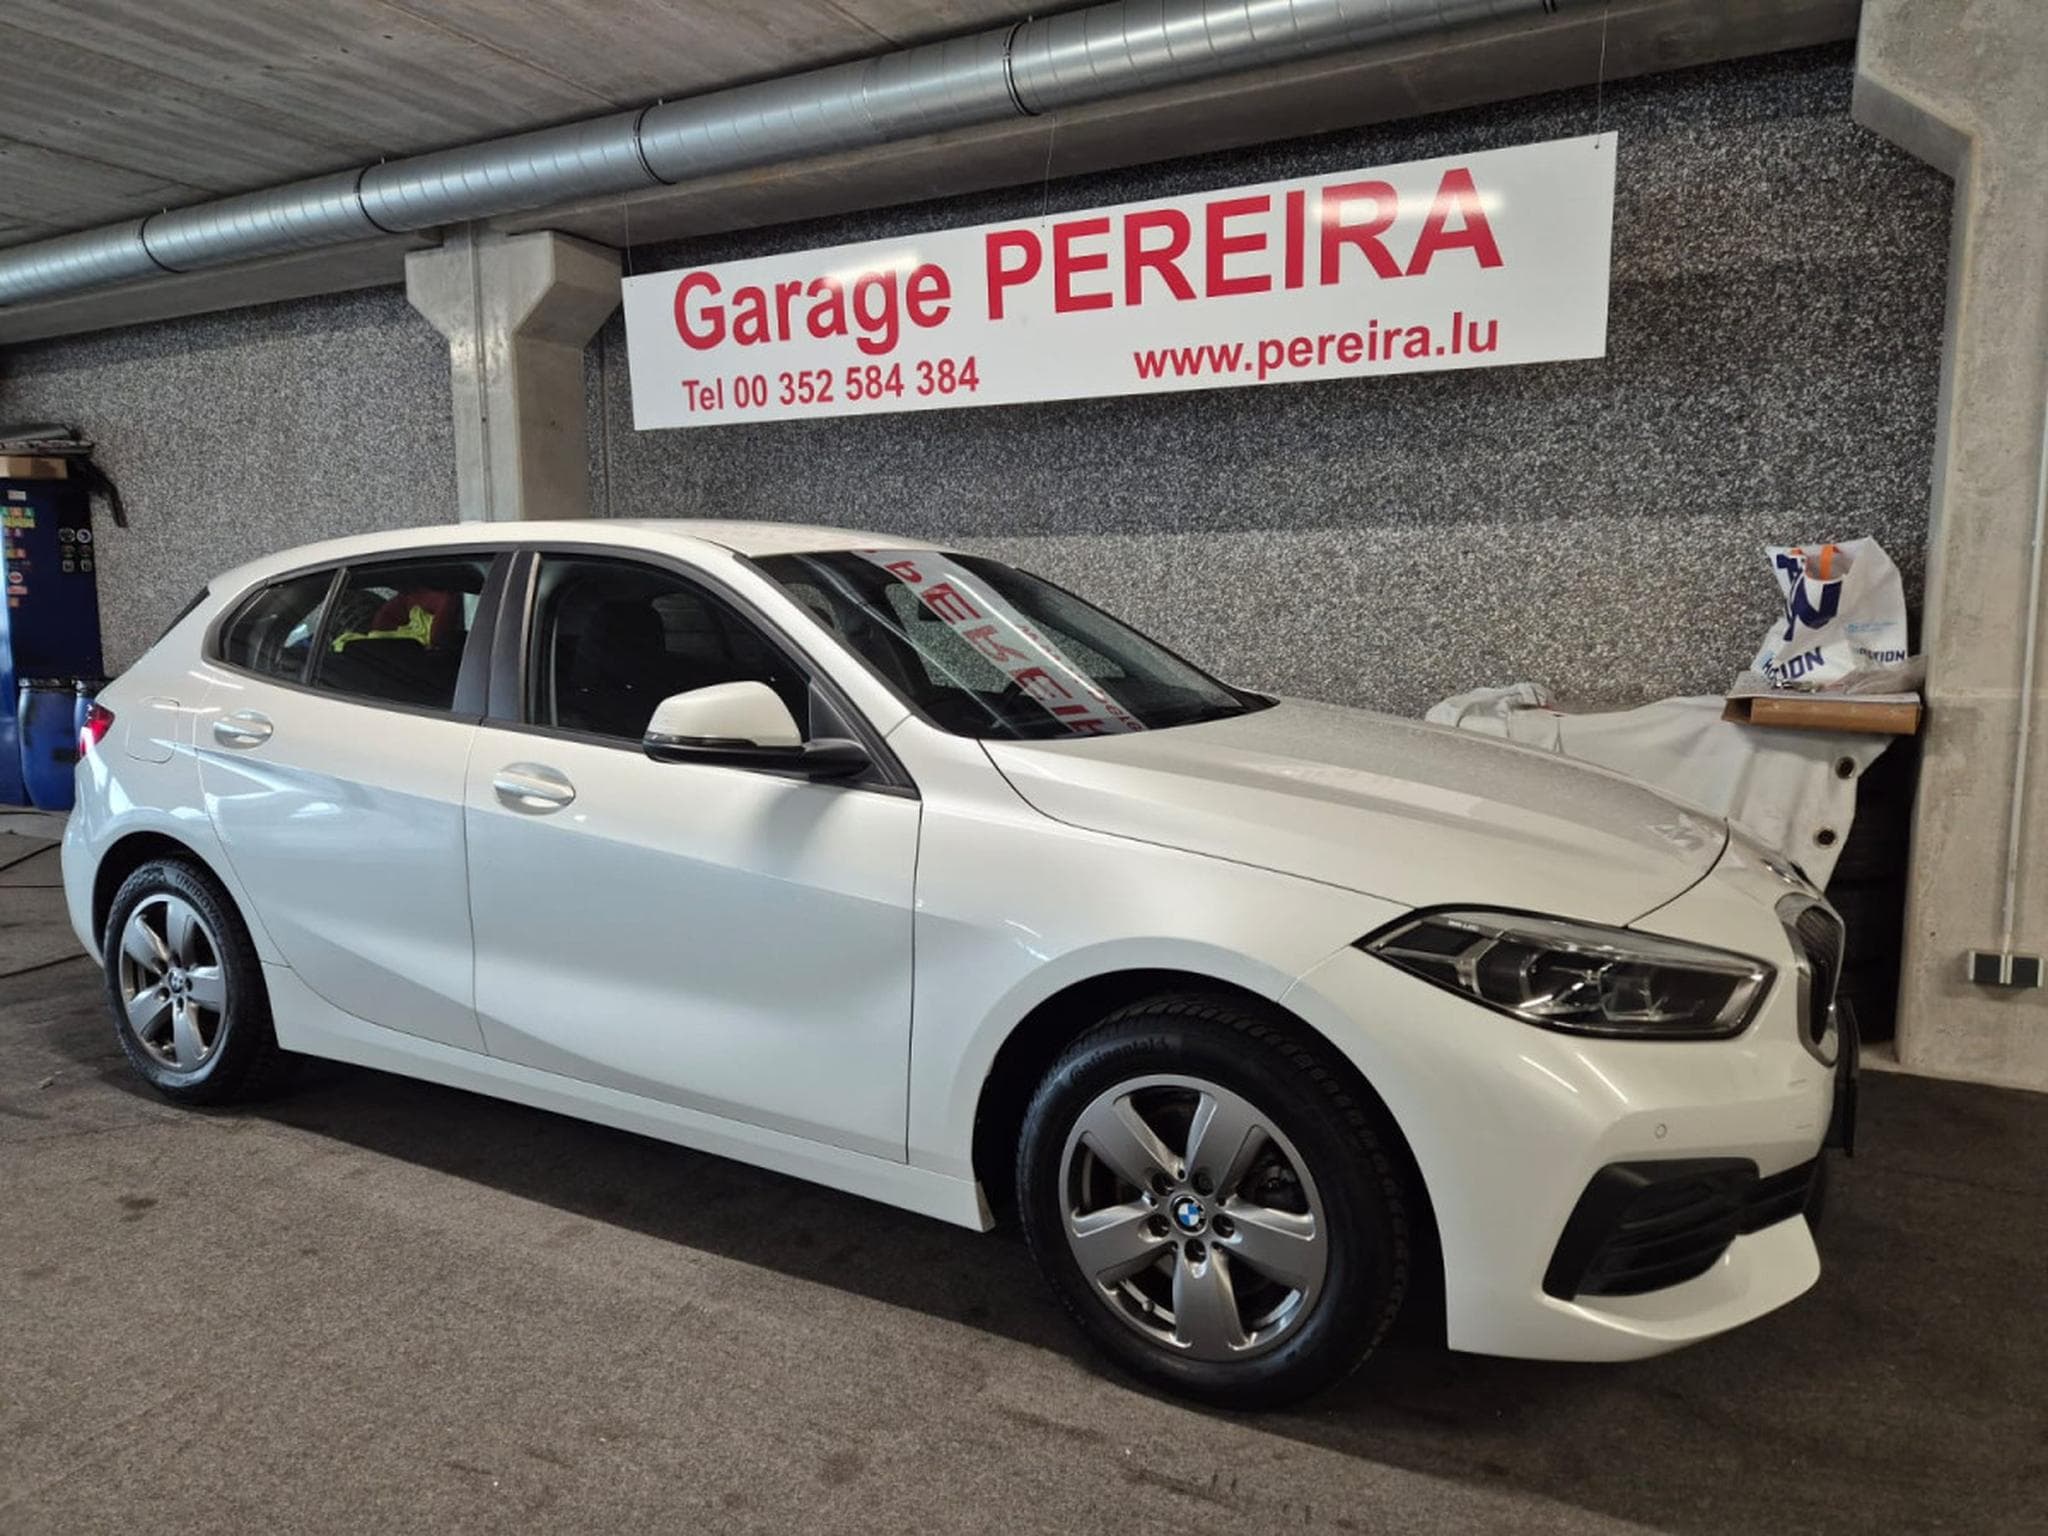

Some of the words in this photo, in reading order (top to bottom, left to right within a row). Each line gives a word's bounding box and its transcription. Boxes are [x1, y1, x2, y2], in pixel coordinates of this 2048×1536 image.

[673, 263, 952, 357] Garage
[985, 167, 1504, 321] PEREIRA
[1133, 311, 1499, 382] www.pereira.lu
[682, 379, 724, 412] Tel
[733, 375, 769, 410] 00
[778, 370, 834, 407] 352
[845, 362, 905, 402] 584
[916, 356, 980, 398] 384
